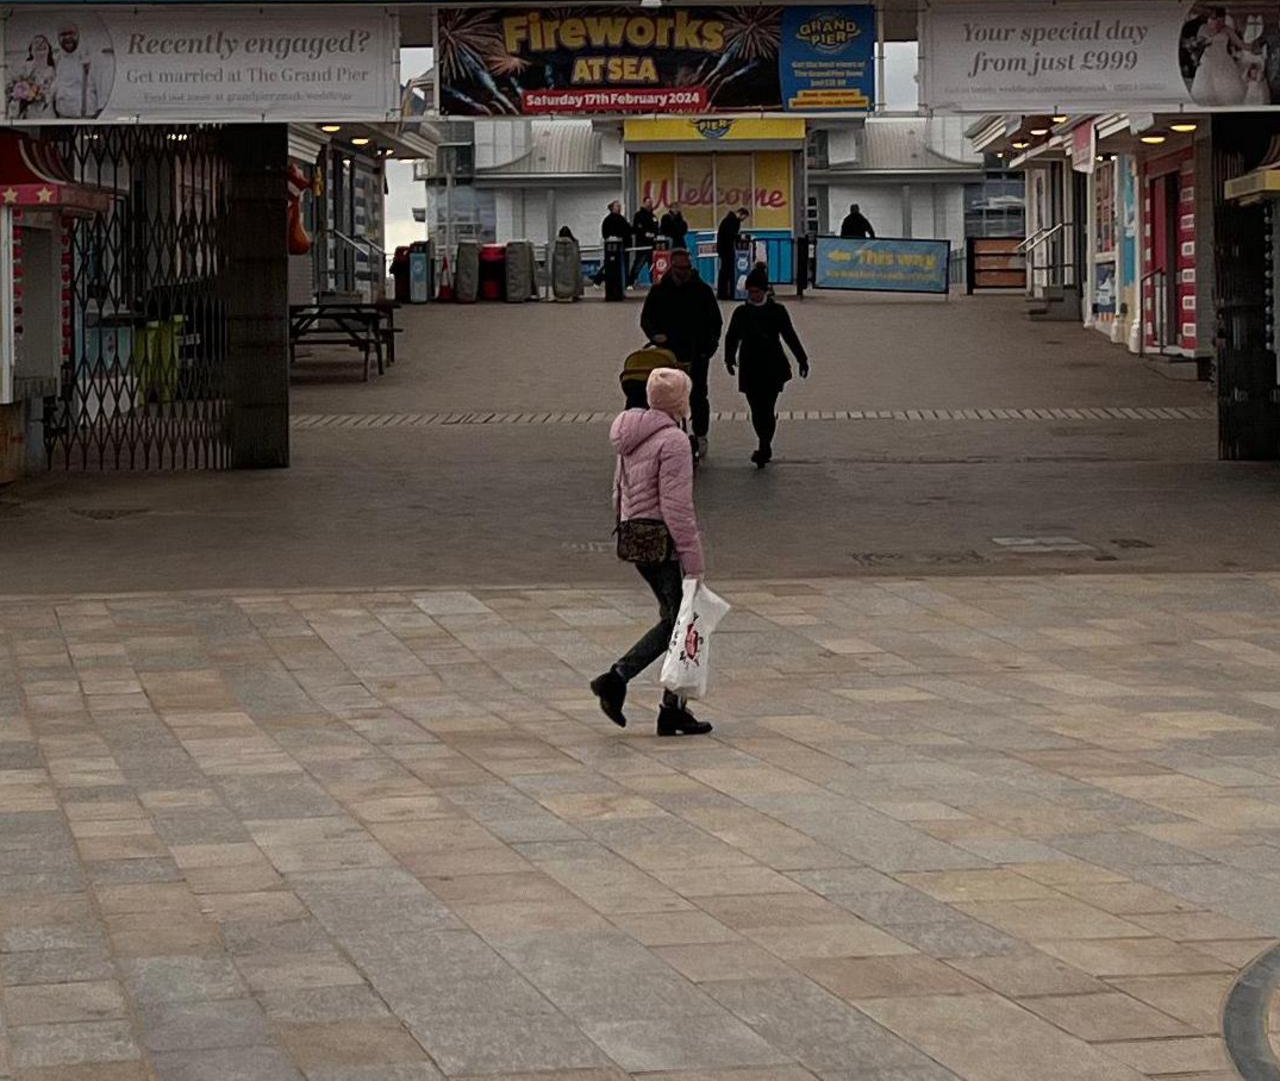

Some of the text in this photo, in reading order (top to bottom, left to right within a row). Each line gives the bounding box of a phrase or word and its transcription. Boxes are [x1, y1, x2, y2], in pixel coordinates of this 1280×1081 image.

[502, 10, 726, 53] Fireworks
[799, 18, 857, 35] GRAND
[811, 31, 848, 45] PIER
[962, 18, 1148, 47] Your special day
[127, 29, 371, 60] Recently engaged?
[127, 66, 370, 83] Get married at The Grand Pier
[572, 56, 659, 84] AT SEA
[967, 49, 1139, 78] from just £999
[526, 92, 701, 108] Saturday 17th February 2024
[643, 172, 788, 208] Welcome
